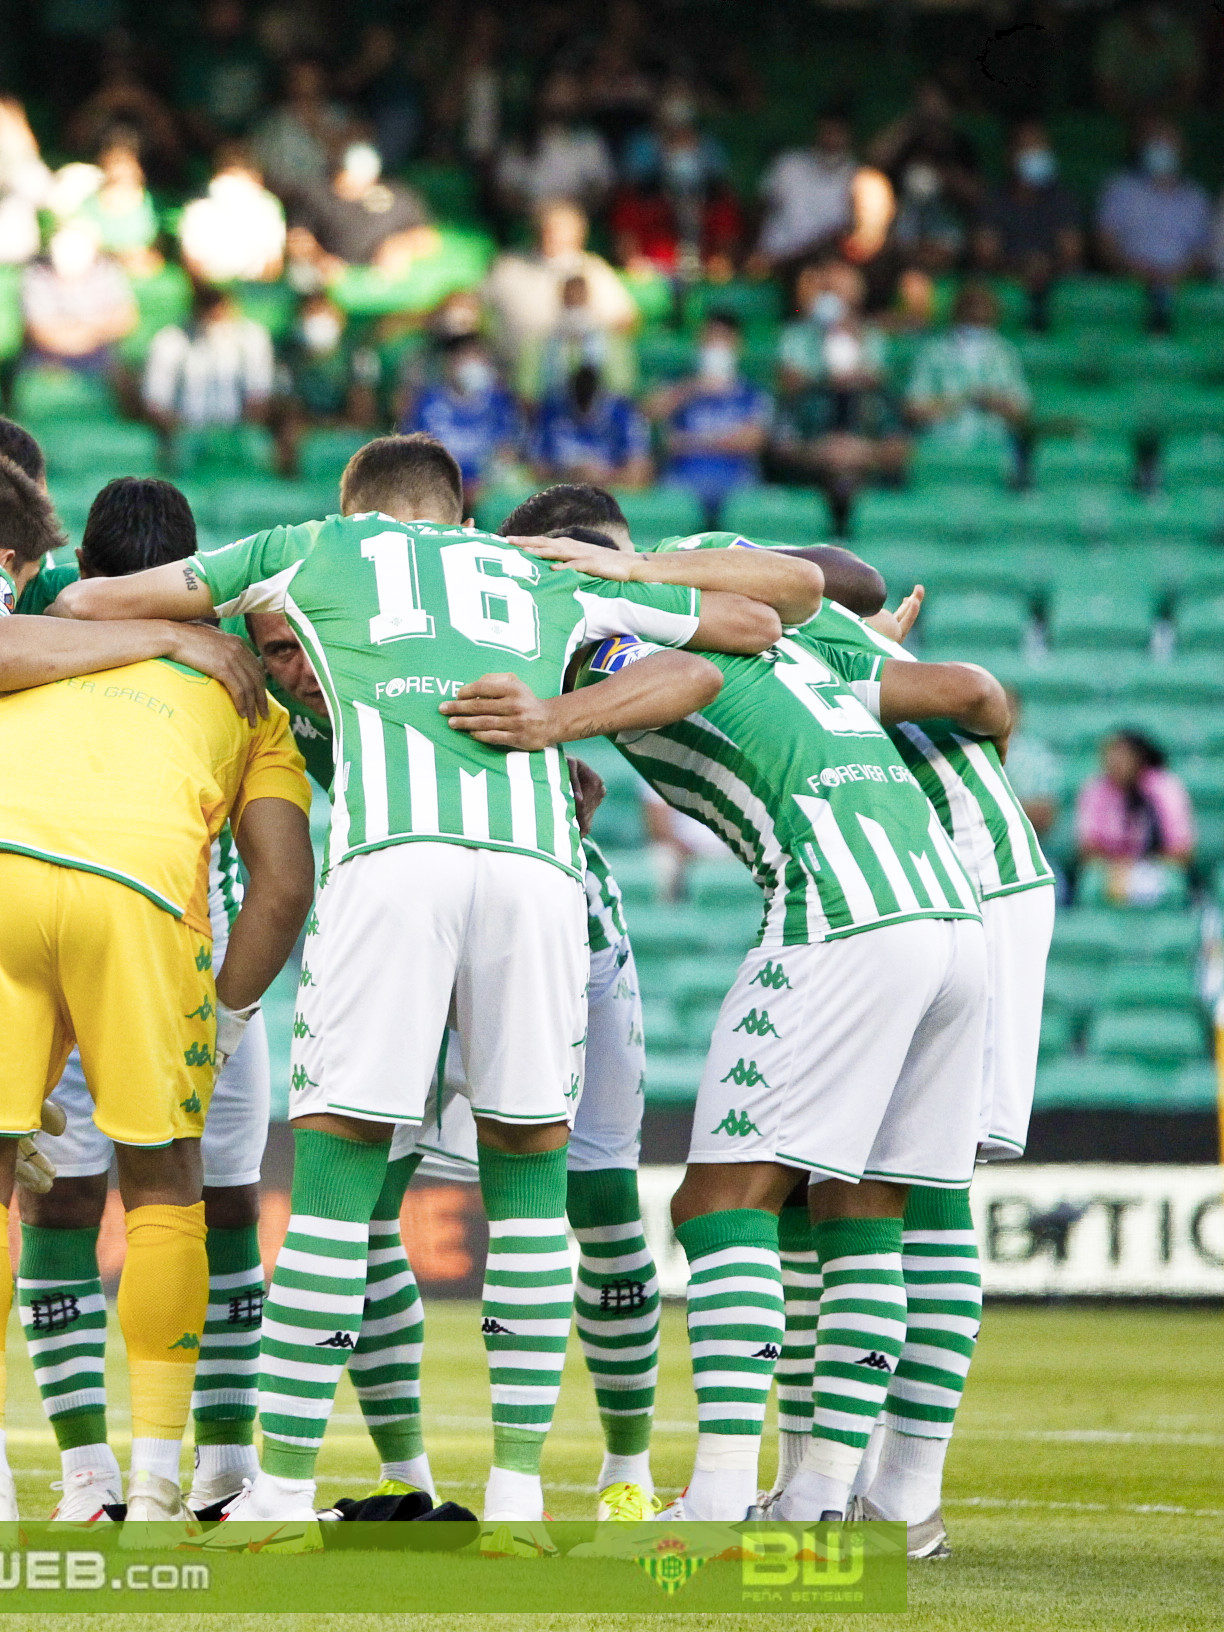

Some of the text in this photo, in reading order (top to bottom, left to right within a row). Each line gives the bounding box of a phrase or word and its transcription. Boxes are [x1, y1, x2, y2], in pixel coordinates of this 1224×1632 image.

[360, 531, 541, 660] 16
[104, 686, 175, 719] GREEN
[375, 676, 465, 700] FOREVE
[760, 636, 888, 739] 2
[806, 763, 888, 794] FOREVER
